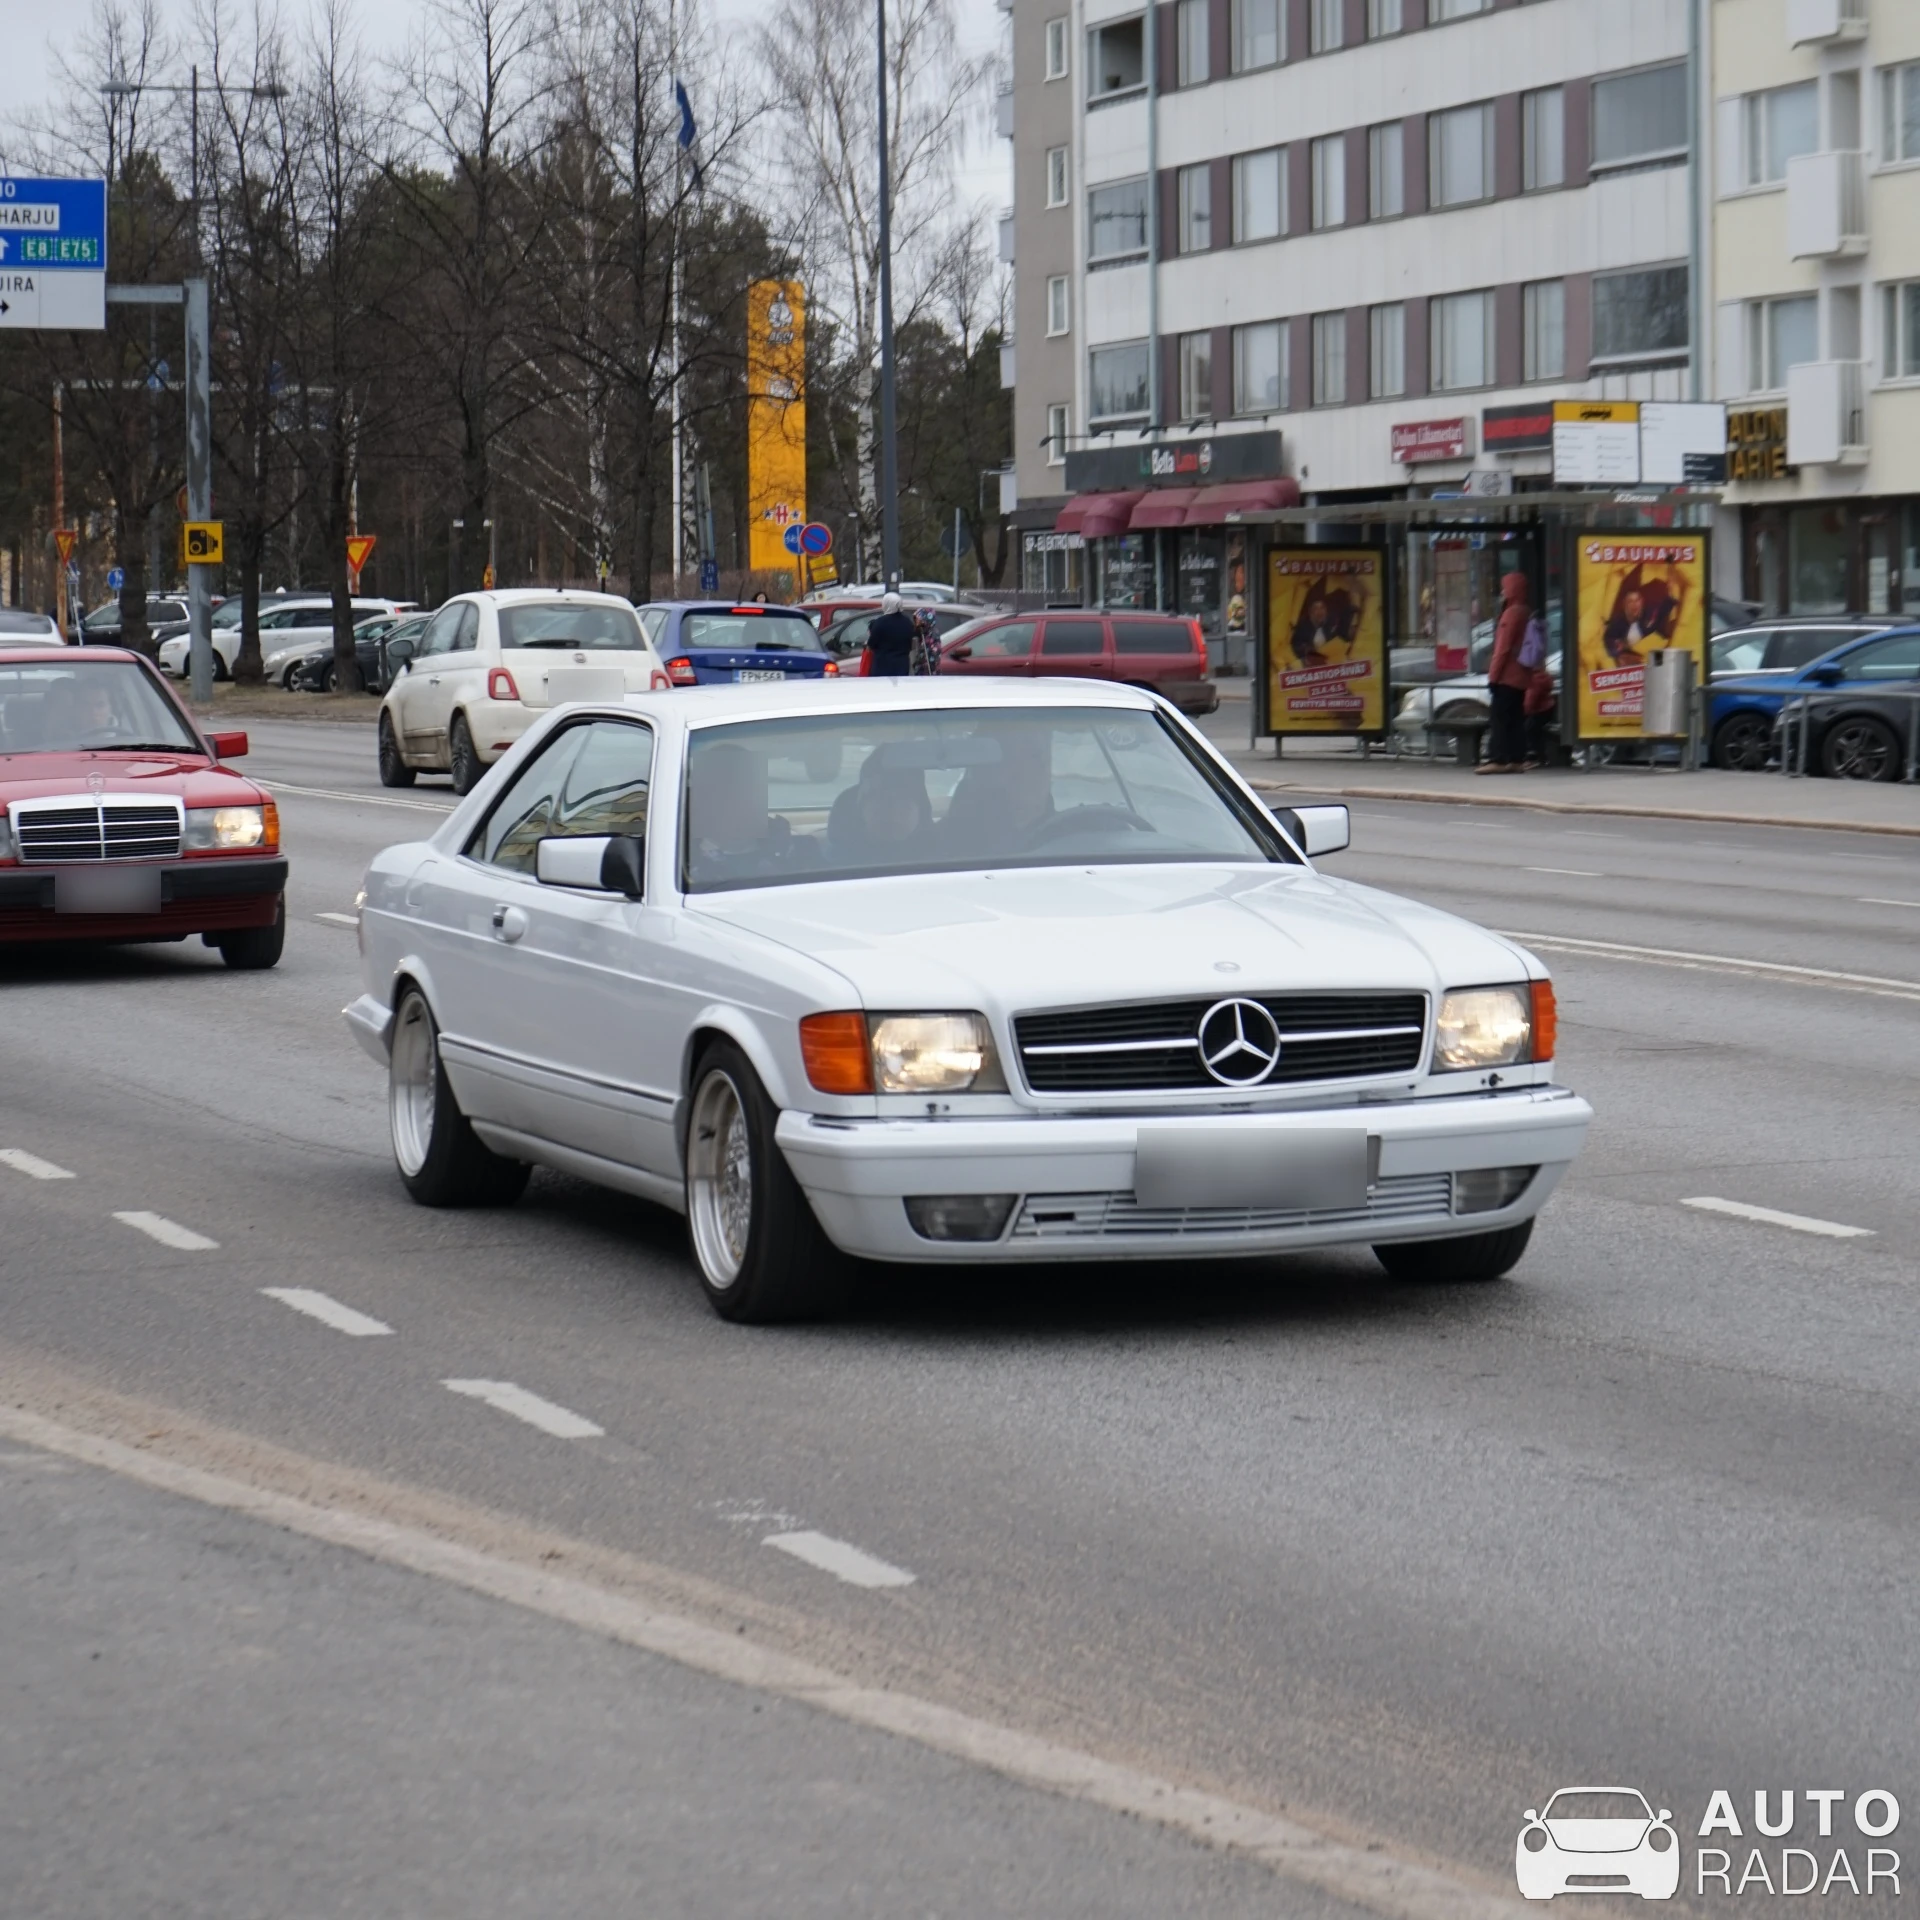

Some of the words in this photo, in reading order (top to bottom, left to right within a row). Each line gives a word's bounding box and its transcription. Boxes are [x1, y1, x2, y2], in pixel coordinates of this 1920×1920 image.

[26, 240, 48, 258] E8
[60, 240, 91, 259] E75
[1152, 448, 1175, 474] Bella
[1604, 547, 1694, 561] BAUHAUS
[1291, 559, 1373, 573] BAUHAUS
